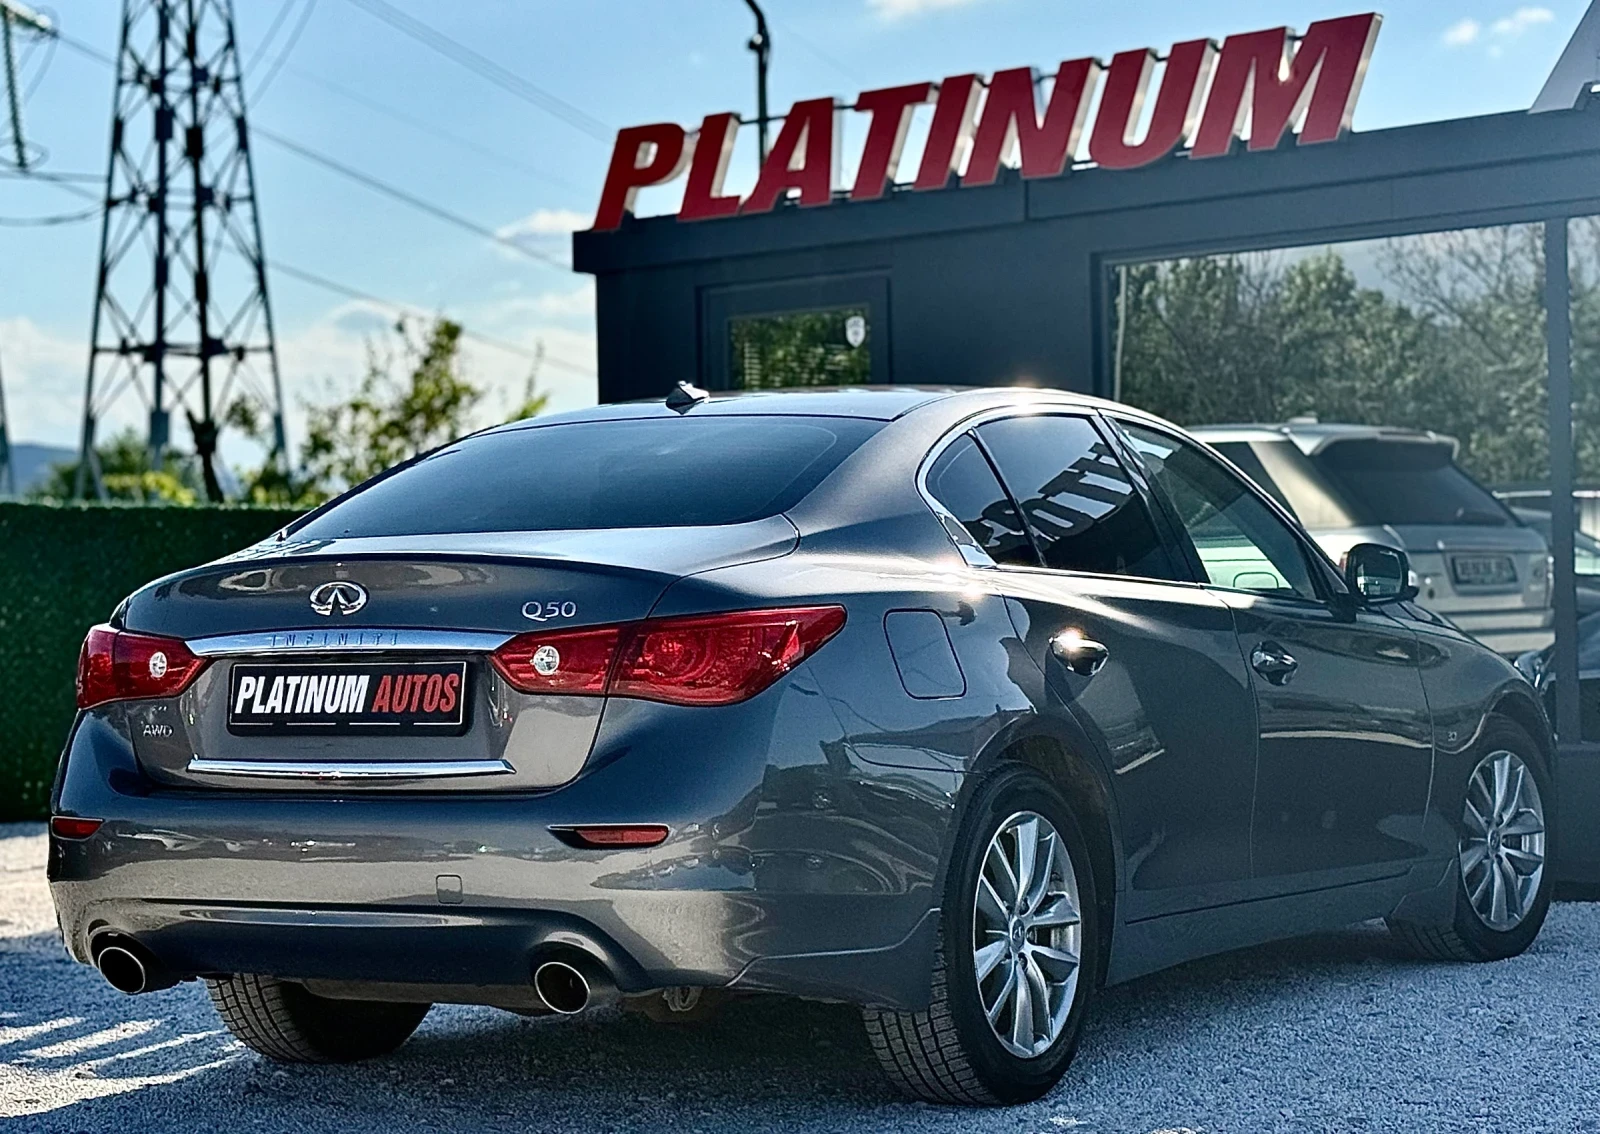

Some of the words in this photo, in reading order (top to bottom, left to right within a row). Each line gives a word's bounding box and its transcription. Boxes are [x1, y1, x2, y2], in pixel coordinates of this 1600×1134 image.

[593, 13, 1382, 231] PLATINUM
[521, 601, 577, 622] Q50
[271, 632, 398, 647] INFINITI
[235, 675, 370, 714] PLATINUM
[371, 674, 459, 713] AUTOS
[142, 723, 173, 738] AWD
